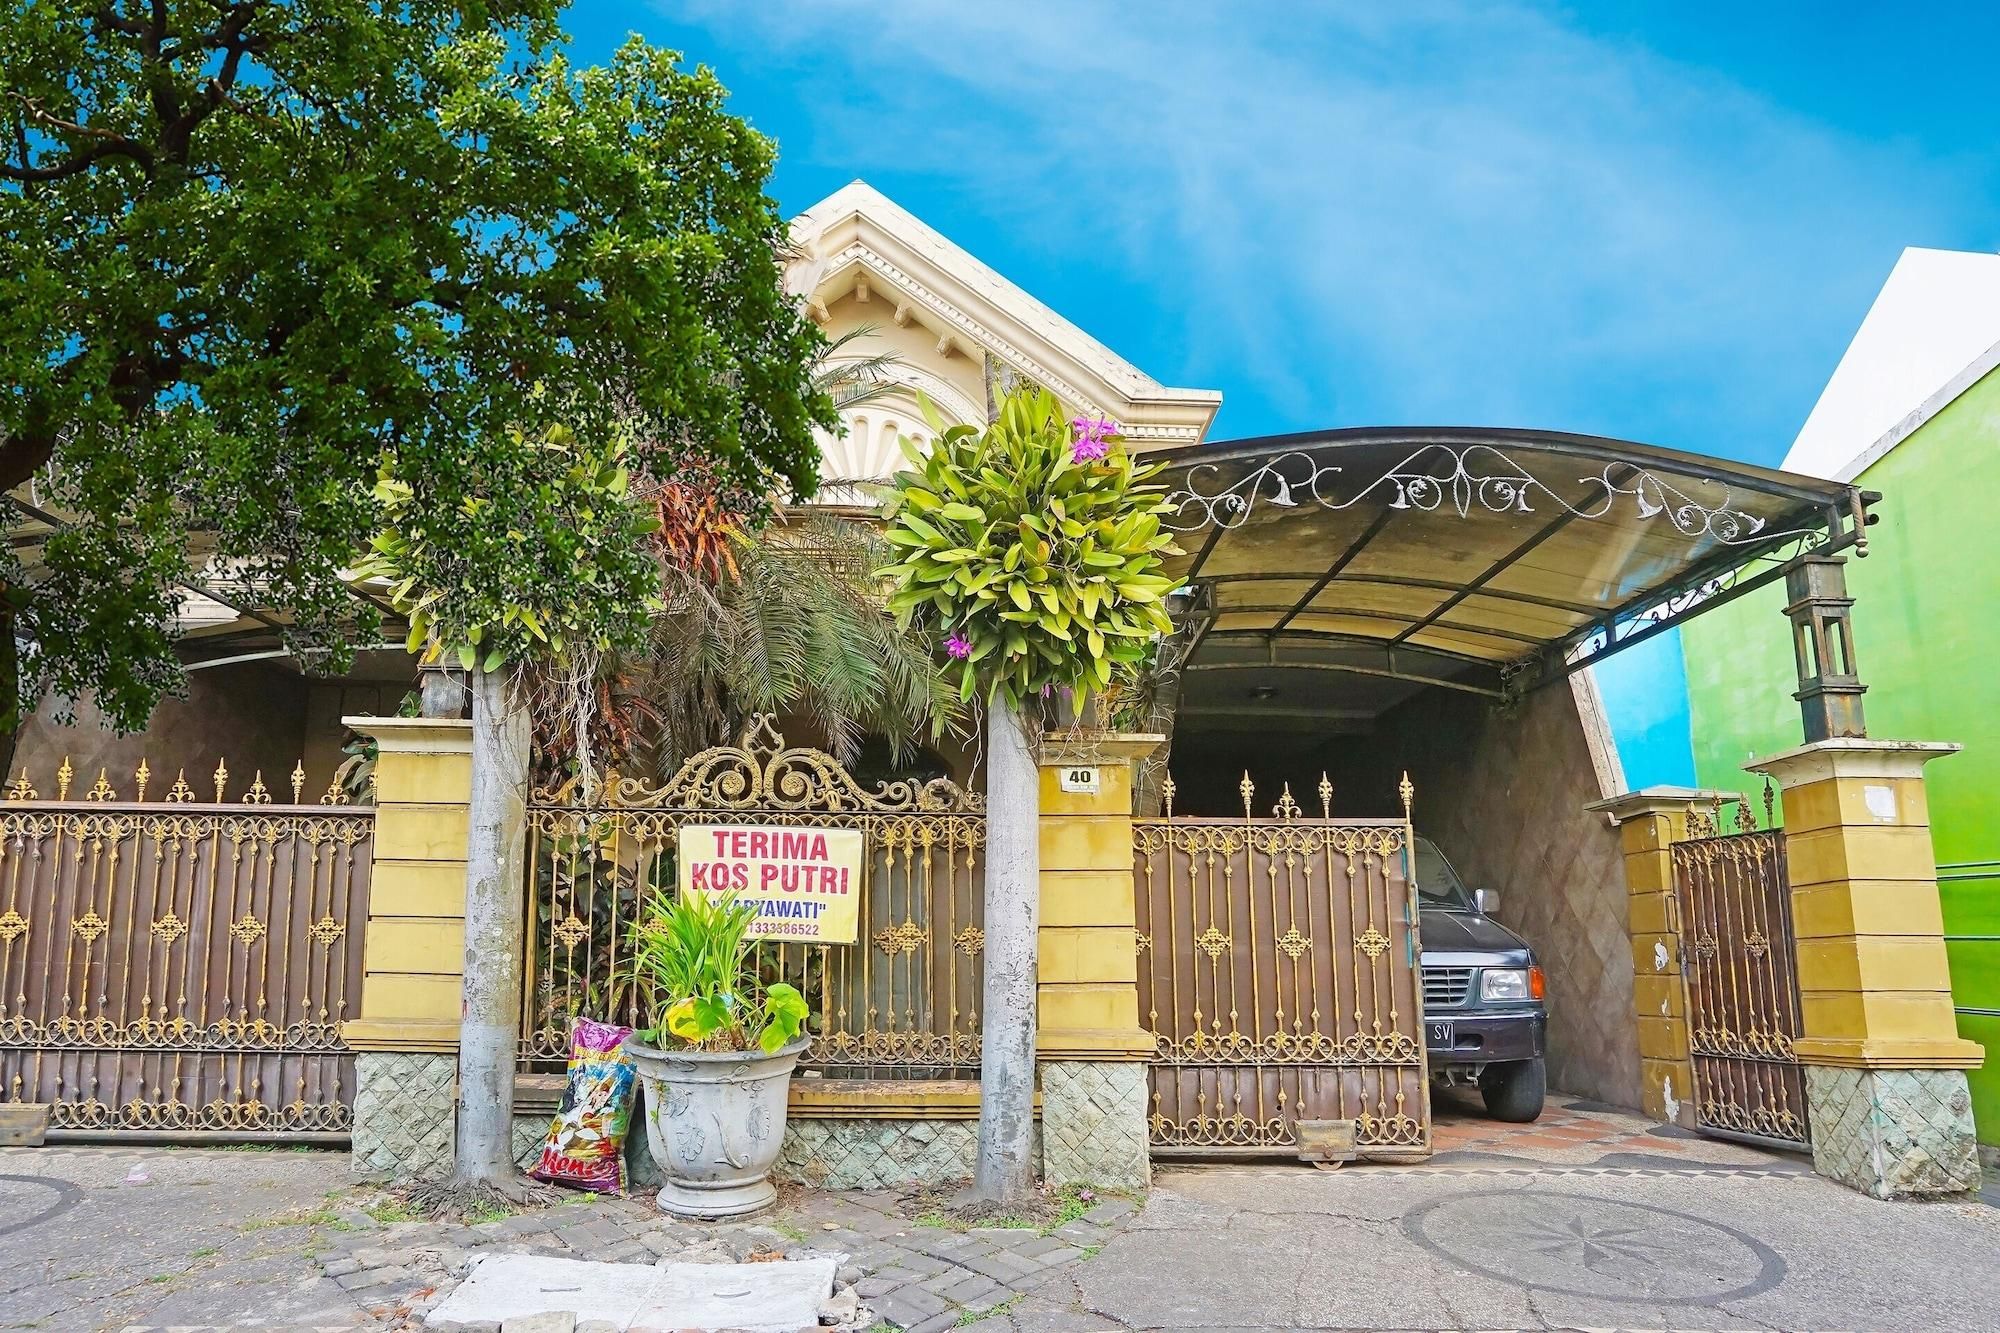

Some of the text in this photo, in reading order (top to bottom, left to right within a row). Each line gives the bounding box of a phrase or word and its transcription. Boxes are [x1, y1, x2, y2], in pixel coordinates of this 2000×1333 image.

[1069, 770, 1091, 783] 40
[712, 831, 828, 861] TERIMA
[692, 862, 849, 894] KOS PUTRI
[1434, 1024, 1450, 1040] SV
